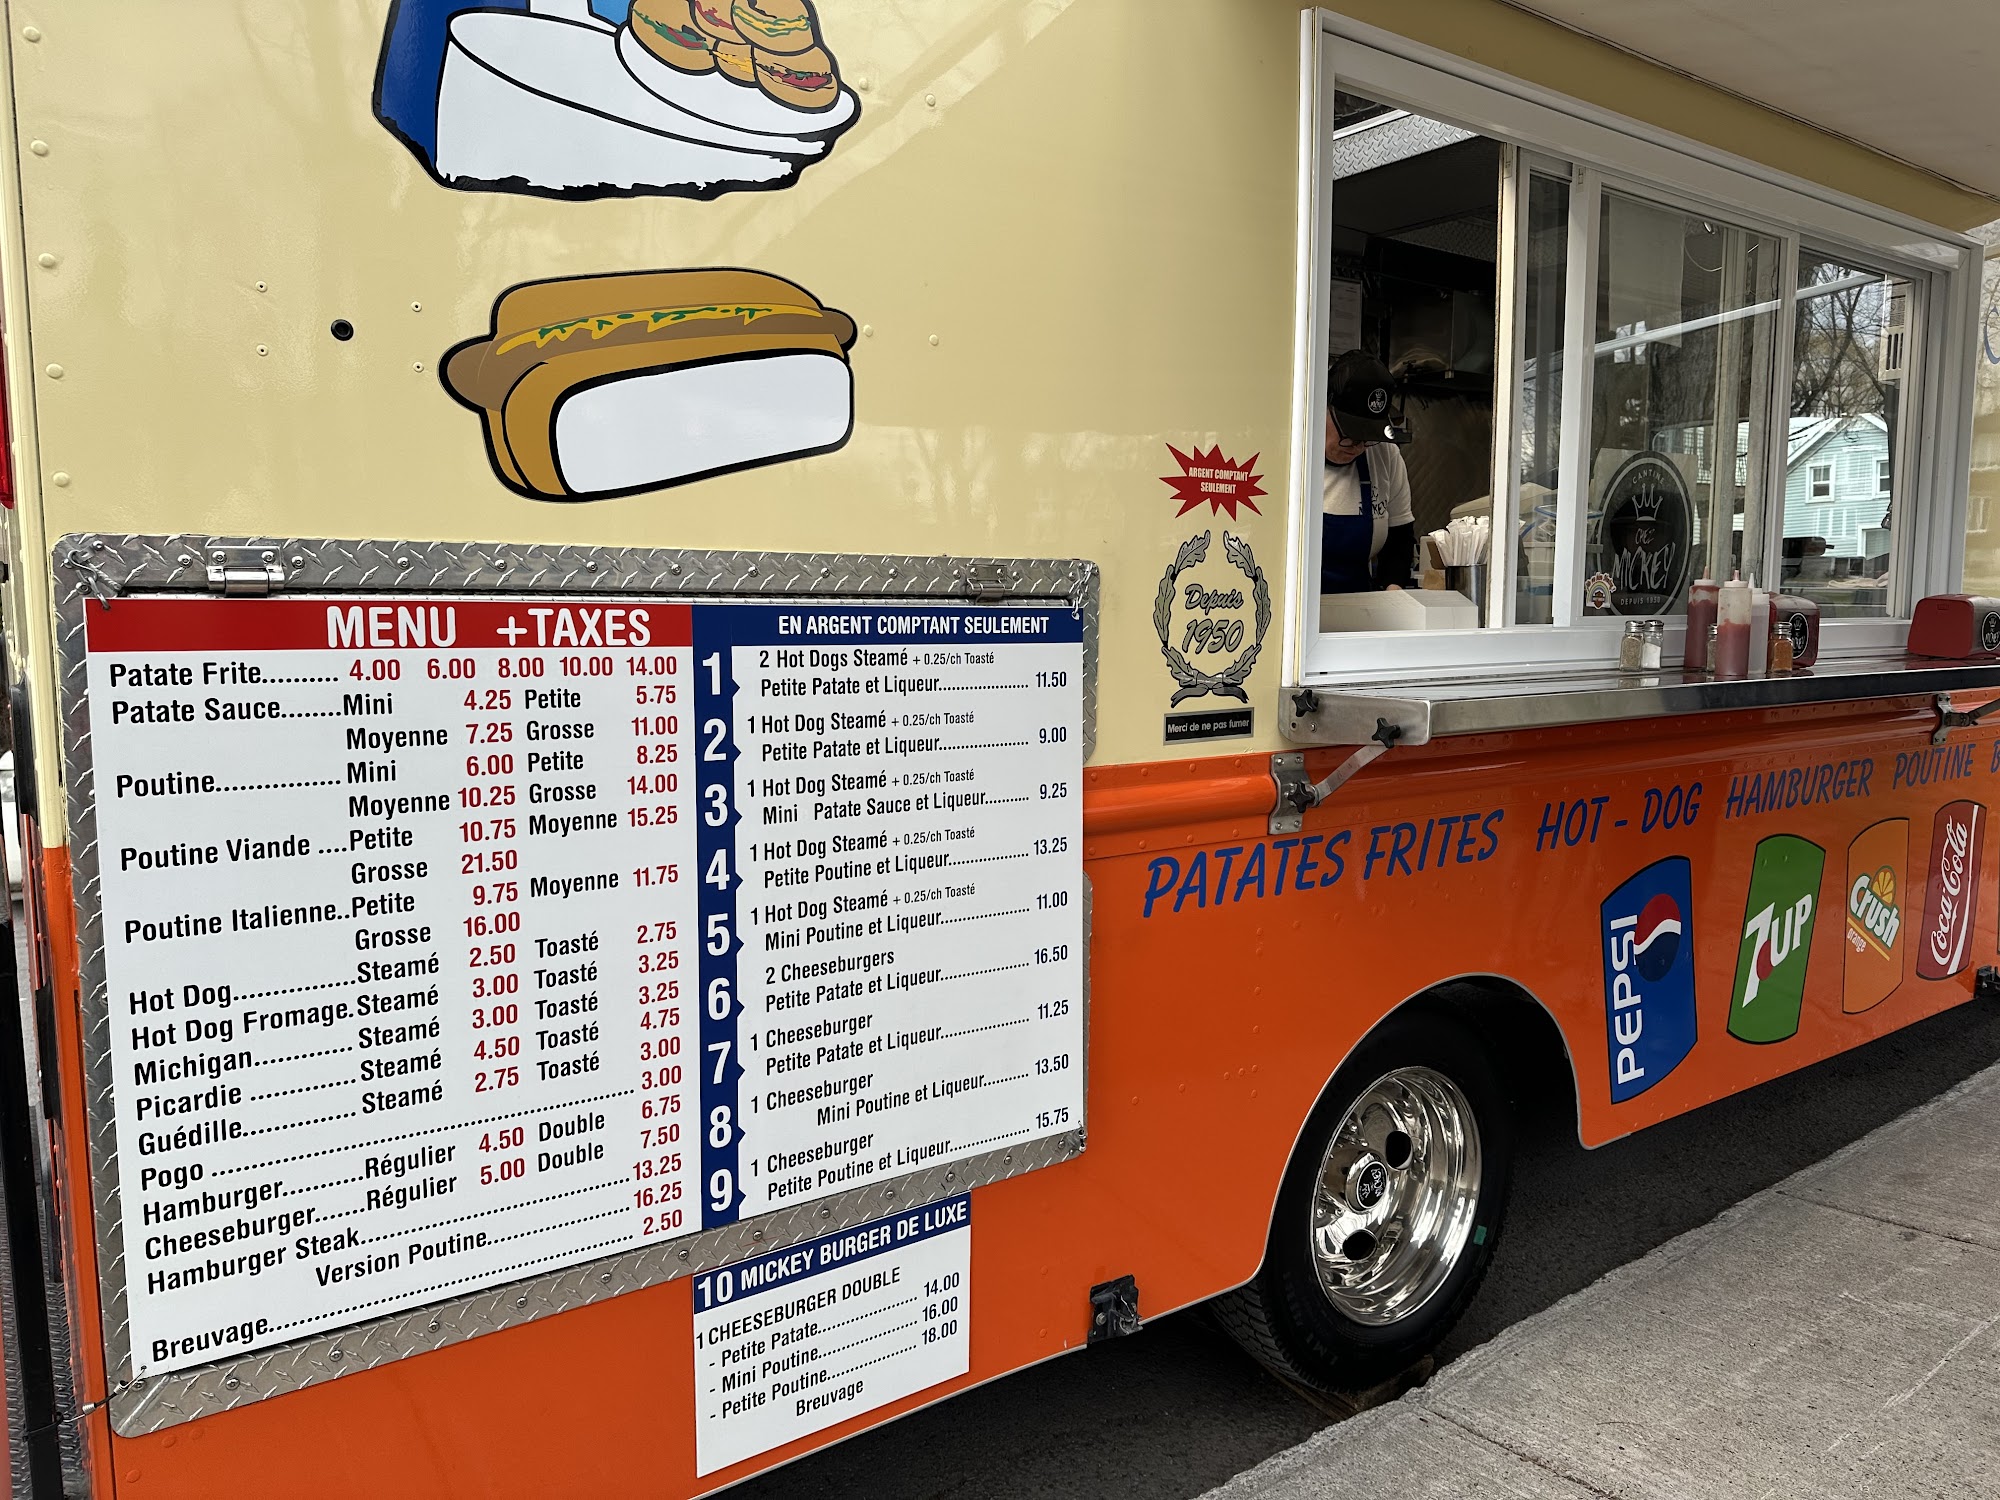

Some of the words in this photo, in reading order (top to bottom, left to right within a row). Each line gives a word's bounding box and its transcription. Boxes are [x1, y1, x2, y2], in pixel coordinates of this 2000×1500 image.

[1188, 467, 1214, 479] ARGENT
[1215, 470, 1248, 482] COMPTANT
[1200, 481, 1236, 494] SEULEMENT
[1632, 469, 1665, 485] CANTINE
[1612, 542, 1676, 590] MICKEY
[1184, 583, 1244, 615] Depuis
[326, 606, 456, 648] MENU
[779, 616, 802, 634] EN
[806, 616, 872, 634] ARGENT
[877, 616, 961, 634] COMPTANT
[965, 616, 1049, 634] SEULEMENT
[1182, 619, 1244, 654] 1950
[110, 663, 193, 688] Patate
[349, 659, 401, 681] 4.00
[427, 658, 476, 679] 6.00
[498, 657, 544, 678] 8.00
[560, 656, 613, 676] 10.00
[627, 656, 677, 676] 14.00
[702, 652, 721, 695] 1
[760, 651, 769, 668] 2
[777, 650, 804, 668] Hot
[809, 650, 848, 672] Dogs
[854, 646, 908, 667] Steamé
[924, 652, 961, 665] 0.25/ch
[965, 651, 994, 665] Toasté
[761, 677, 806, 697] Petite
[813, 676, 859, 695] Patate
[865, 677, 880, 694] et
[1035, 671, 1067, 688] 11.50
[112, 700, 195, 724] Patate
[464, 689, 512, 710] 4.25
[525, 688, 581, 709] Petite
[636, 685, 676, 704] 5.75
[1167, 722, 1188, 734] Merci
[1190, 722, 1200, 732] de
[1202, 722, 1211, 732] ne
[1213, 722, 1227, 732] pas
[1229, 718, 1249, 730] fumer
[346, 726, 448, 753] Moyenne
[466, 722, 513, 744] 7.25
[526, 720, 594, 741] Grosse
[632, 716, 678, 736] 11.00
[703, 718, 727, 761] 2
[1039, 726, 1067, 744] 9.00
[466, 754, 513, 777] 6.00
[528, 750, 584, 772] Petite
[636, 744, 678, 764] 8.25
[349, 791, 450, 821] Moyenne
[458, 785, 516, 808] 10.25
[529, 783, 596, 804] Grosse
[627, 773, 678, 795] 14.00
[704, 783, 728, 827] 3
[867, 797, 911, 815] Sauce
[1039, 782, 1067, 800] 9.25
[121, 843, 219, 871] Poutine
[226, 834, 311, 862] Viande
[459, 818, 517, 843] 10.75
[529, 811, 618, 838] Moyenne
[628, 805, 678, 828] 15.25
[1033, 837, 1068, 856] 13.25
[1143, 830, 1351, 918] PATATES
[1363, 809, 1504, 880] FRITES
[1536, 796, 1610, 852] HOT
[1641, 782, 1704, 834] DOG
[1725, 758, 1874, 819] HAMBURGER
[1892, 743, 1976, 790] POUTINE
[351, 860, 428, 884] Grosse
[461, 849, 518, 874] 21.50
[705, 848, 730, 891] 4
[125, 914, 222, 943] Poutine
[473, 882, 518, 905] 9.75
[531, 872, 619, 900] Moyenne
[633, 864, 678, 888] 11.75
[1036, 891, 1068, 910] 11.00
[1849, 874, 1900, 949] Crush
[355, 925, 431, 950] Grosse
[463, 912, 520, 938] 16.00
[707, 913, 730, 956] 5
[1741, 893, 1812, 1008] 7UP
[1846, 927, 1867, 954] orange
[130, 989, 175, 1015] Hot
[357, 952, 439, 984] Steamé
[469, 943, 516, 968] 2.50
[535, 932, 599, 959] Toasté
[637, 921, 677, 944] 2.75
[1034, 945, 1068, 965] 16.50
[132, 1024, 176, 1050] Hot
[186, 1018, 233, 1042] Dog
[472, 973, 519, 998] 3.00
[534, 962, 598, 989] Toasté
[638, 951, 679, 974] 3.25
[707, 977, 731, 1020] 6
[782, 950, 894, 984] Cheeseburgers
[1610, 914, 1645, 1084] PEPSI
[358, 1016, 440, 1049] Steamé
[472, 1004, 518, 1029] 3.00
[535, 991, 598, 1020] Toasté
[639, 980, 679, 1005] 3.25
[1038, 1000, 1069, 1020] 11.25
[137, 1084, 242, 1121] Picardie
[360, 1048, 442, 1082] Steamé
[474, 1036, 520, 1061] 4.50
[536, 1021, 599, 1051] Toasté
[640, 1007, 680, 1031] 4.75
[708, 1041, 732, 1085] 7
[766, 1013, 873, 1049] Cheeseburger
[1035, 1053, 1069, 1075] 13.50
[362, 1079, 443, 1114] Steamé
[474, 1066, 519, 1093] 2.75
[537, 1052, 600, 1081] Toasté
[640, 1036, 681, 1061] 3.00
[141, 1163, 204, 1191] Pogo
[641, 1065, 682, 1090] 3.00
[479, 1127, 524, 1153] 4.50
[538, 1112, 605, 1142] Double
[642, 1094, 681, 1119] 6.75
[709, 1105, 732, 1148] 8
[766, 1072, 874, 1112] Cheeseburger
[1036, 1107, 1069, 1130] 15.75
[480, 1158, 525, 1185] 5.00
[538, 1142, 604, 1172] Double
[641, 1123, 680, 1149] 7.50
[710, 1169, 732, 1212] 9
[767, 1132, 874, 1173] Cheeseburger
[147, 1247, 286, 1295] Hamburger
[632, 1152, 682, 1181] 13.25
[316, 1253, 400, 1287] Version
[634, 1181, 682, 1209] 16.25
[643, 1209, 683, 1236] 2.50
[698, 1271, 733, 1308] 10
[741, 1249, 814, 1290] MICKEY
[820, 1225, 891, 1266] BURGER
[896, 1216, 919, 1241] DE
[924, 1200, 967, 1232] LUXE
[696, 1332, 703, 1349] 1
[708, 1288, 836, 1344] CHEESEBURGER
[842, 1266, 901, 1300] DOUBLE
[721, 1340, 766, 1368] Petite
[924, 1272, 959, 1298] 14.00
[722, 1366, 756, 1393] Mini
[922, 1296, 958, 1322] 16.00
[722, 1391, 766, 1419] Petite
[922, 1319, 958, 1346] 18.00
[796, 1379, 864, 1417] Breuvage
